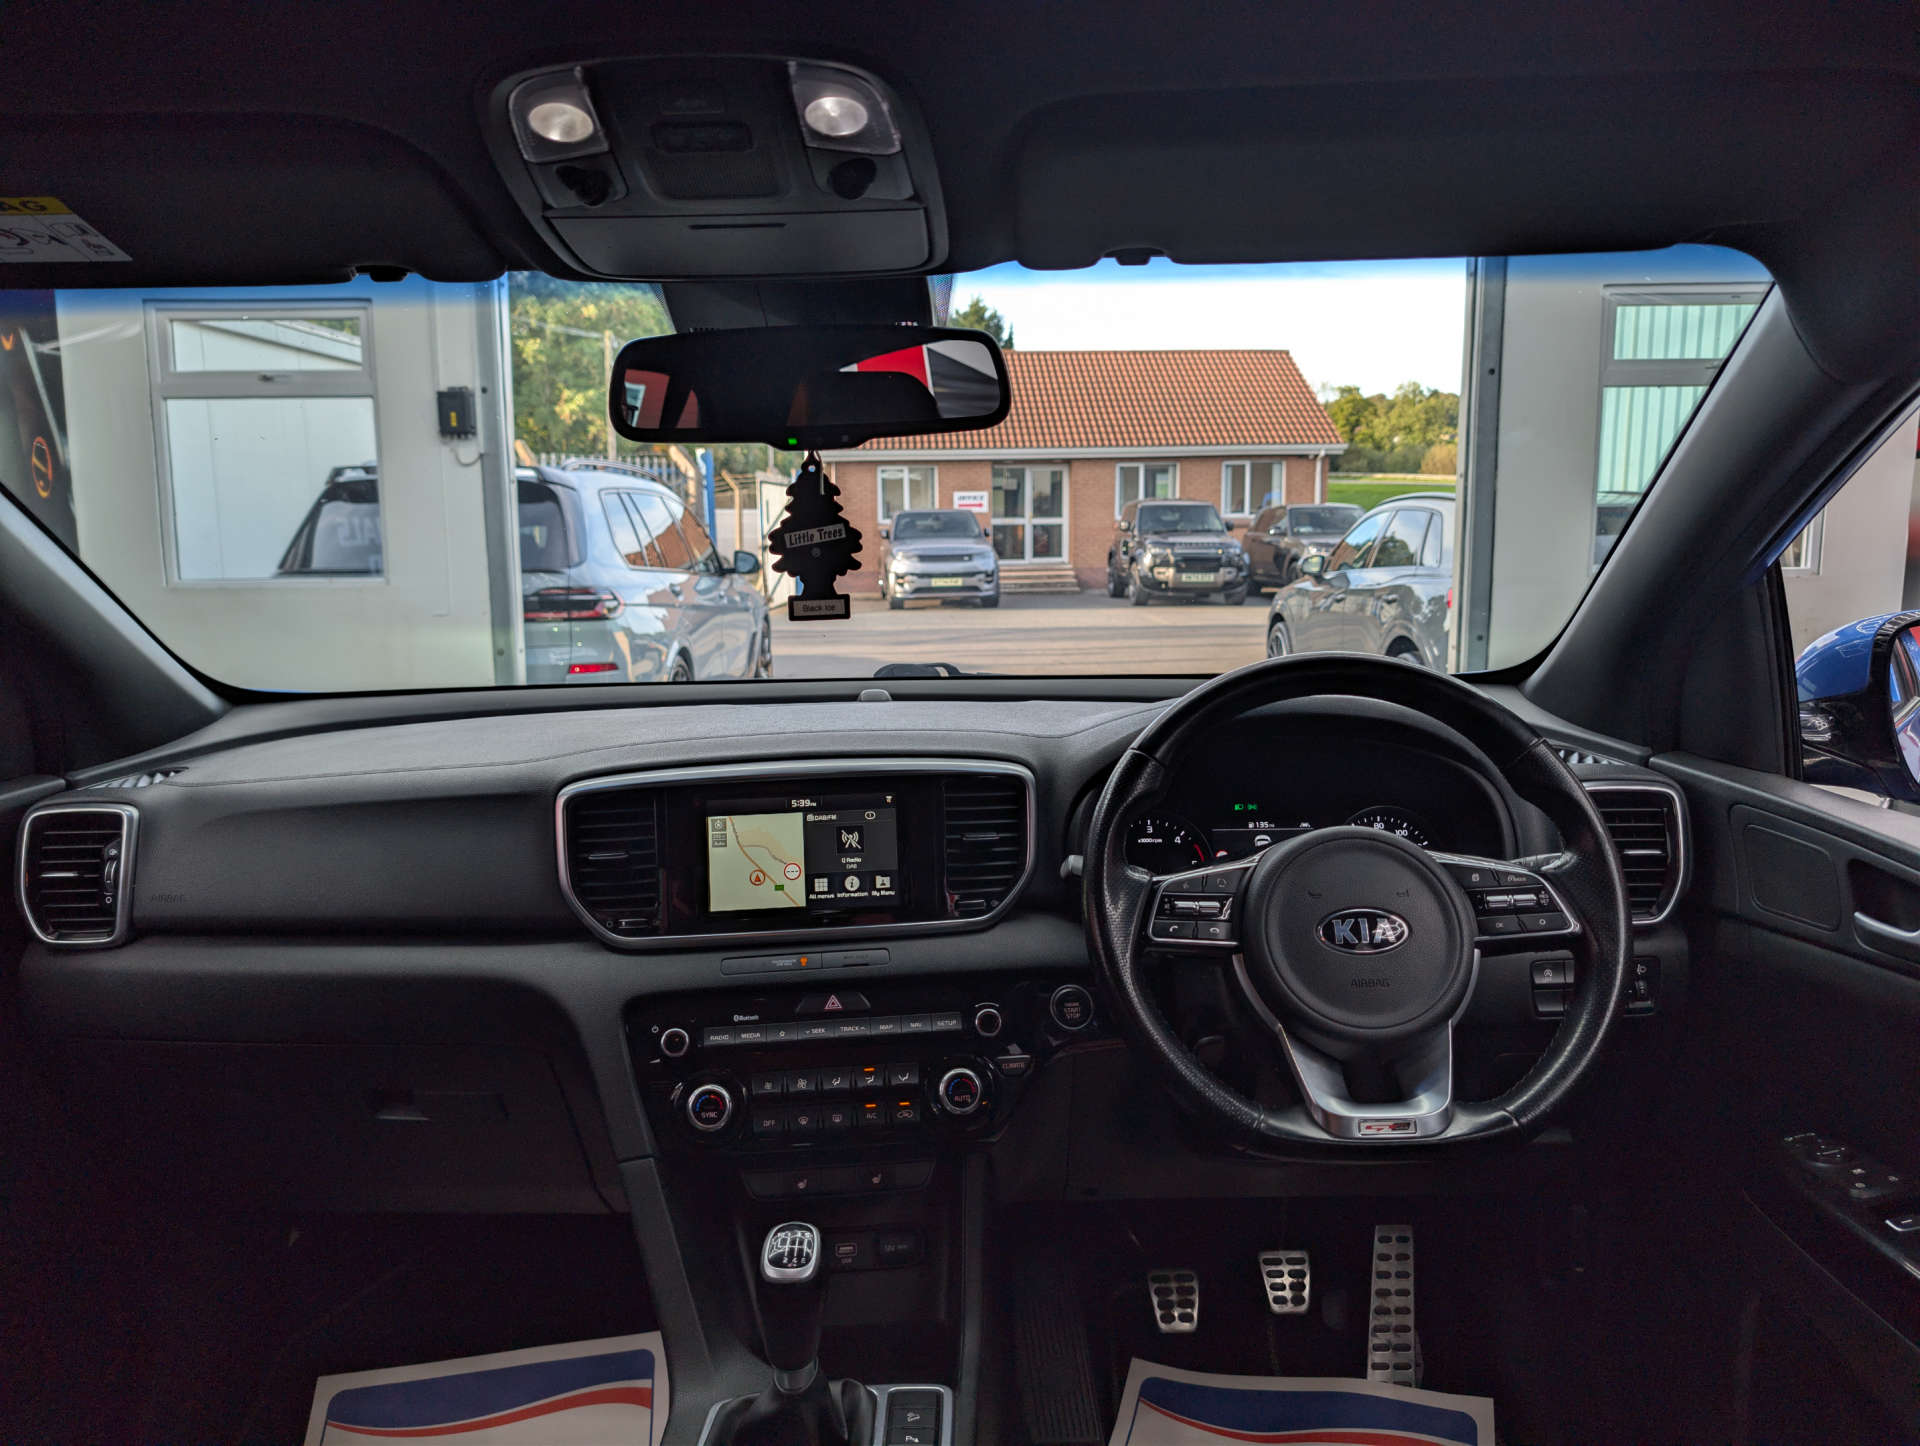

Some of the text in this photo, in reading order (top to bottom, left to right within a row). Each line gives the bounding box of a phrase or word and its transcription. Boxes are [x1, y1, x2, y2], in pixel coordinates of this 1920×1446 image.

[788, 527, 843, 546] Little Trees
[1394, 829, 1408, 837] 100
[1331, 916, 1403, 944] KIA
[1351, 977, 1391, 989] AIRBAG
[811, 1027, 826, 1035] SEEK
[740, 1032, 761, 1040] MEDIA
[701, 1111, 718, 1119] SYNC
[763, 1119, 776, 1128] OFF
